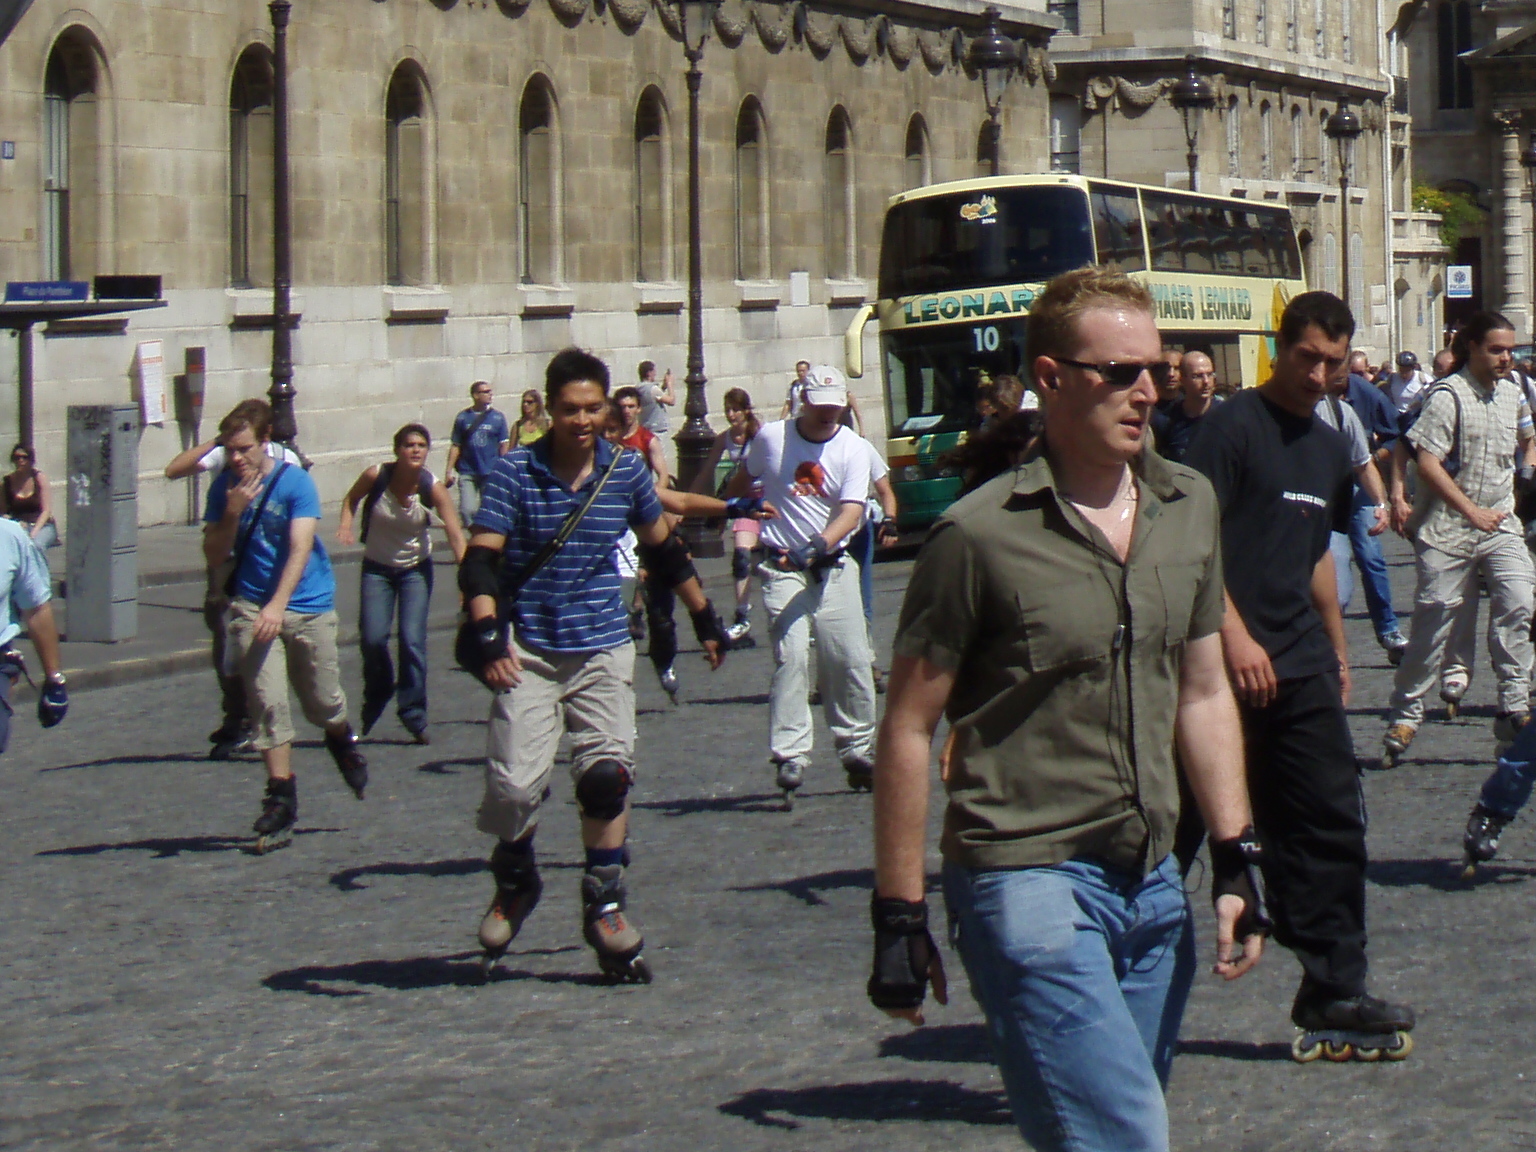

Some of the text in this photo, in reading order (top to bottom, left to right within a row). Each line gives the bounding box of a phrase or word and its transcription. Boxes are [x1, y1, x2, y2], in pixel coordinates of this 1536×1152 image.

[904, 288, 1046, 325] LEONAR
[1200, 286, 1252, 321] LEONARD
[972, 325, 1000, 352] 10
